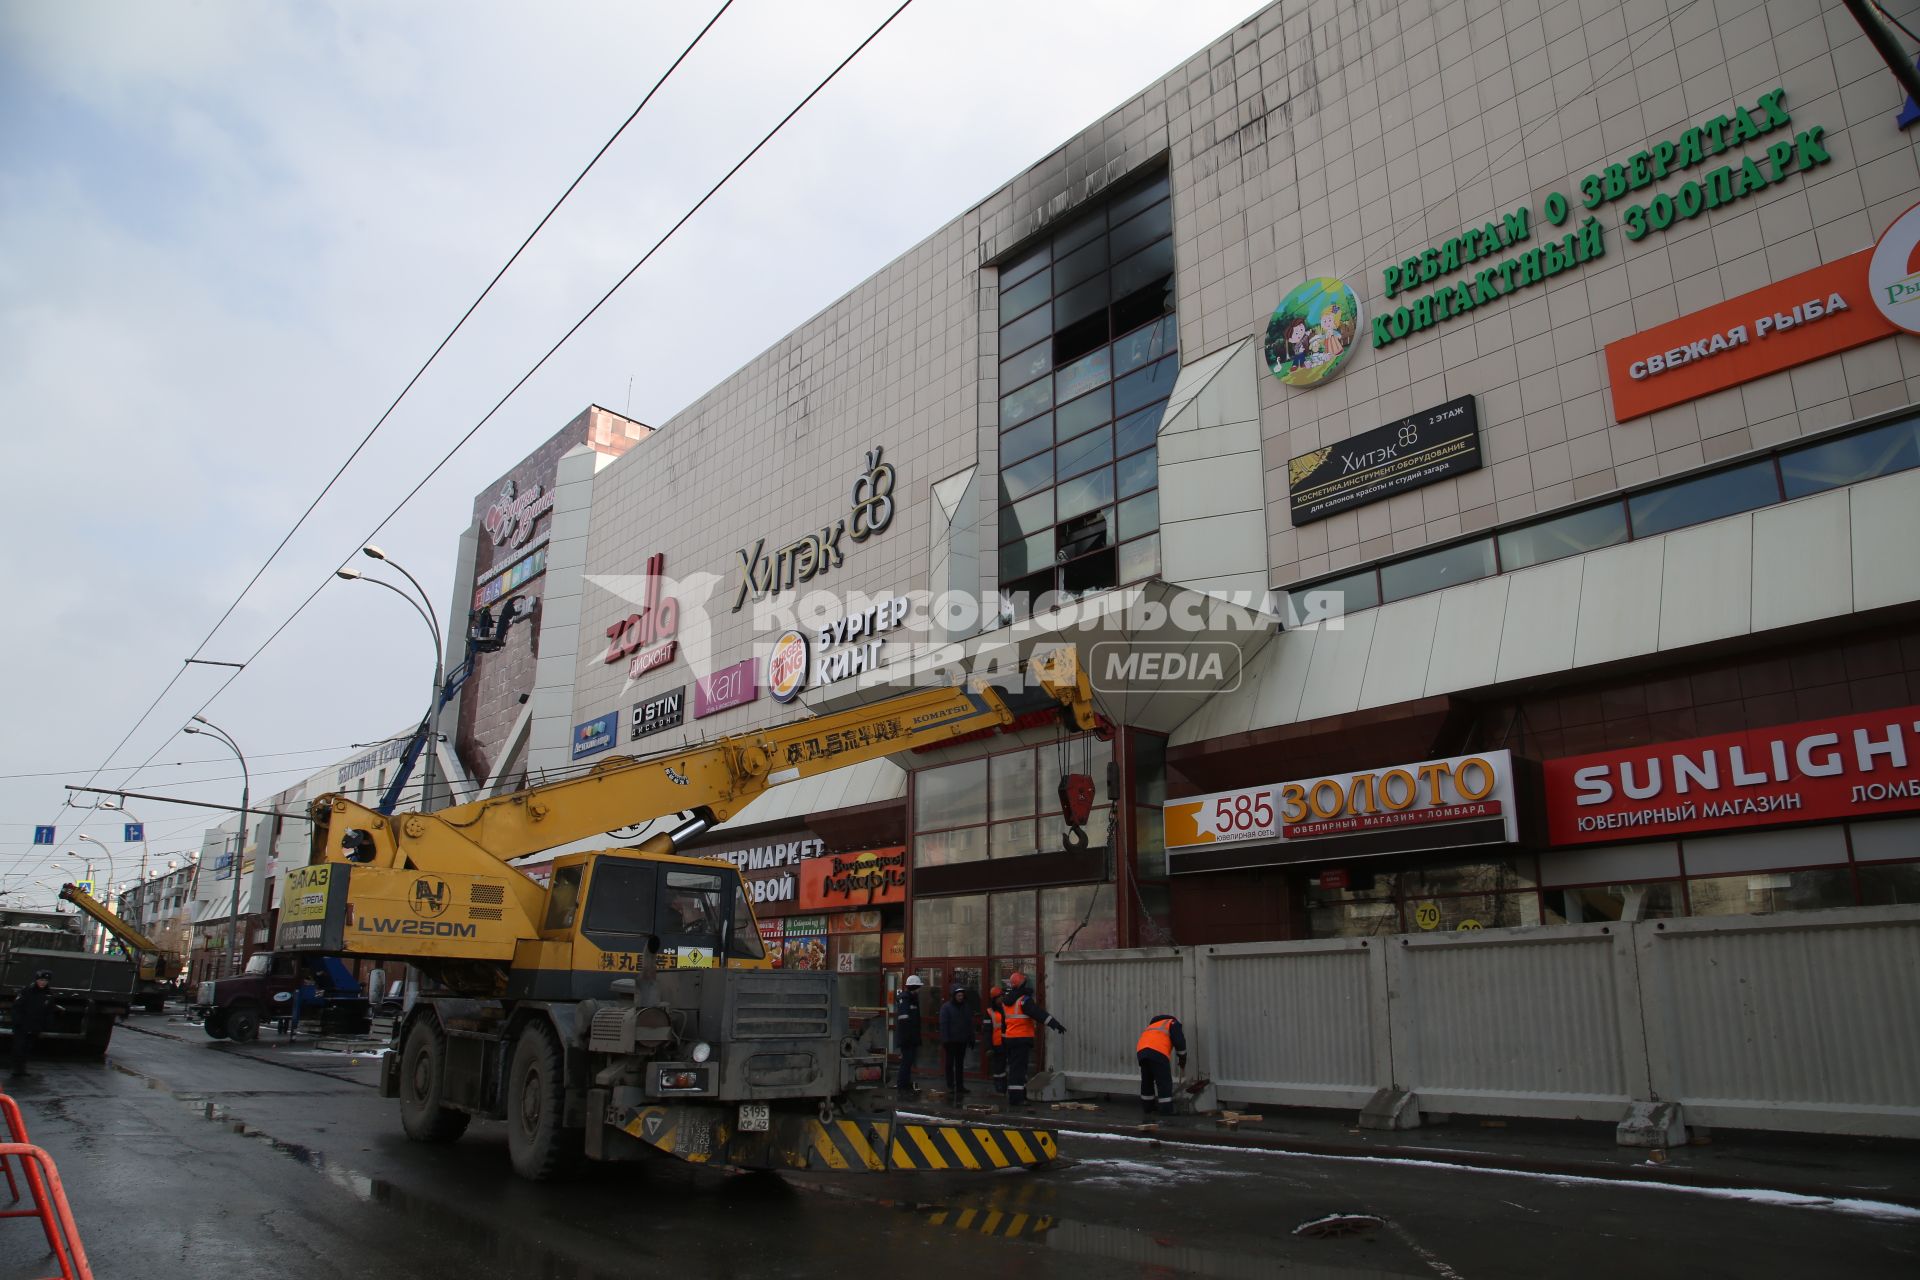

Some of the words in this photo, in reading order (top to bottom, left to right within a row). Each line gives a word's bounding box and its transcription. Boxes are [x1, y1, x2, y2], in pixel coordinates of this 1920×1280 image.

[1383, 206, 1530, 299] РЕБЯТАМ
[1544, 192, 1568, 226] О
[1579, 88, 1791, 209] ЗВЕРЯТАХ
[1370, 216, 1606, 350] КОНТАКТНЫЙ
[1624, 125, 1830, 242] ЗООПАРК
[1885, 283, 1920, 305] Ры
[1628, 323, 1749, 381] СВЕЖАЯ
[1755, 292, 1848, 337] РЫБА
[1429, 416, 1434, 425] 2
[1436, 406, 1464, 422] ЭТАЖ
[1310, 503, 1324, 513] для
[1325, 493, 1355, 508] салонов
[1356, 483, 1387, 498] красоты
[1395, 469, 1422, 486] студий
[1423, 462, 1450, 476] загара
[605, 553, 678, 664] zolla
[817, 595, 910, 653] БУРГЕР
[630, 643, 675, 677] ДИСКОНТ
[771, 638, 802, 671] BURGER
[771, 651, 803, 687] KING
[816, 638, 885, 687] КИНГ
[706, 663, 742, 705] kari
[912, 704, 969, 725] KOMATSU
[1574, 720, 1920, 806] SUNLIGH
[1281, 757, 1495, 823] ЗОЛОТО
[1578, 801, 1697, 832] ЮВЕЛИРНЫЙ
[1703, 793, 1802, 819] МАГАЗИН
[1851, 779, 1920, 803] ЛОМБ
[1216, 791, 1274, 832] 585
[1292, 818, 1358, 834] ЮВЕЛИРНЫЙ
[1364, 812, 1415, 826] МАГАЗИН
[1427, 804, 1486, 819] ЛОМБАРД
[1216, 831, 1256, 842] ювелирная
[1257, 829, 1275, 837] сеть
[699, 839, 825, 871] ЕРМАРКЕТ
[291, 868, 329, 890] ЗАКАЗ
[358, 917, 476, 937] LW250M
[840, 954, 853, 966] 24
[743, 1106, 767, 1118] 5195
[757, 1121, 767, 1129] 42
